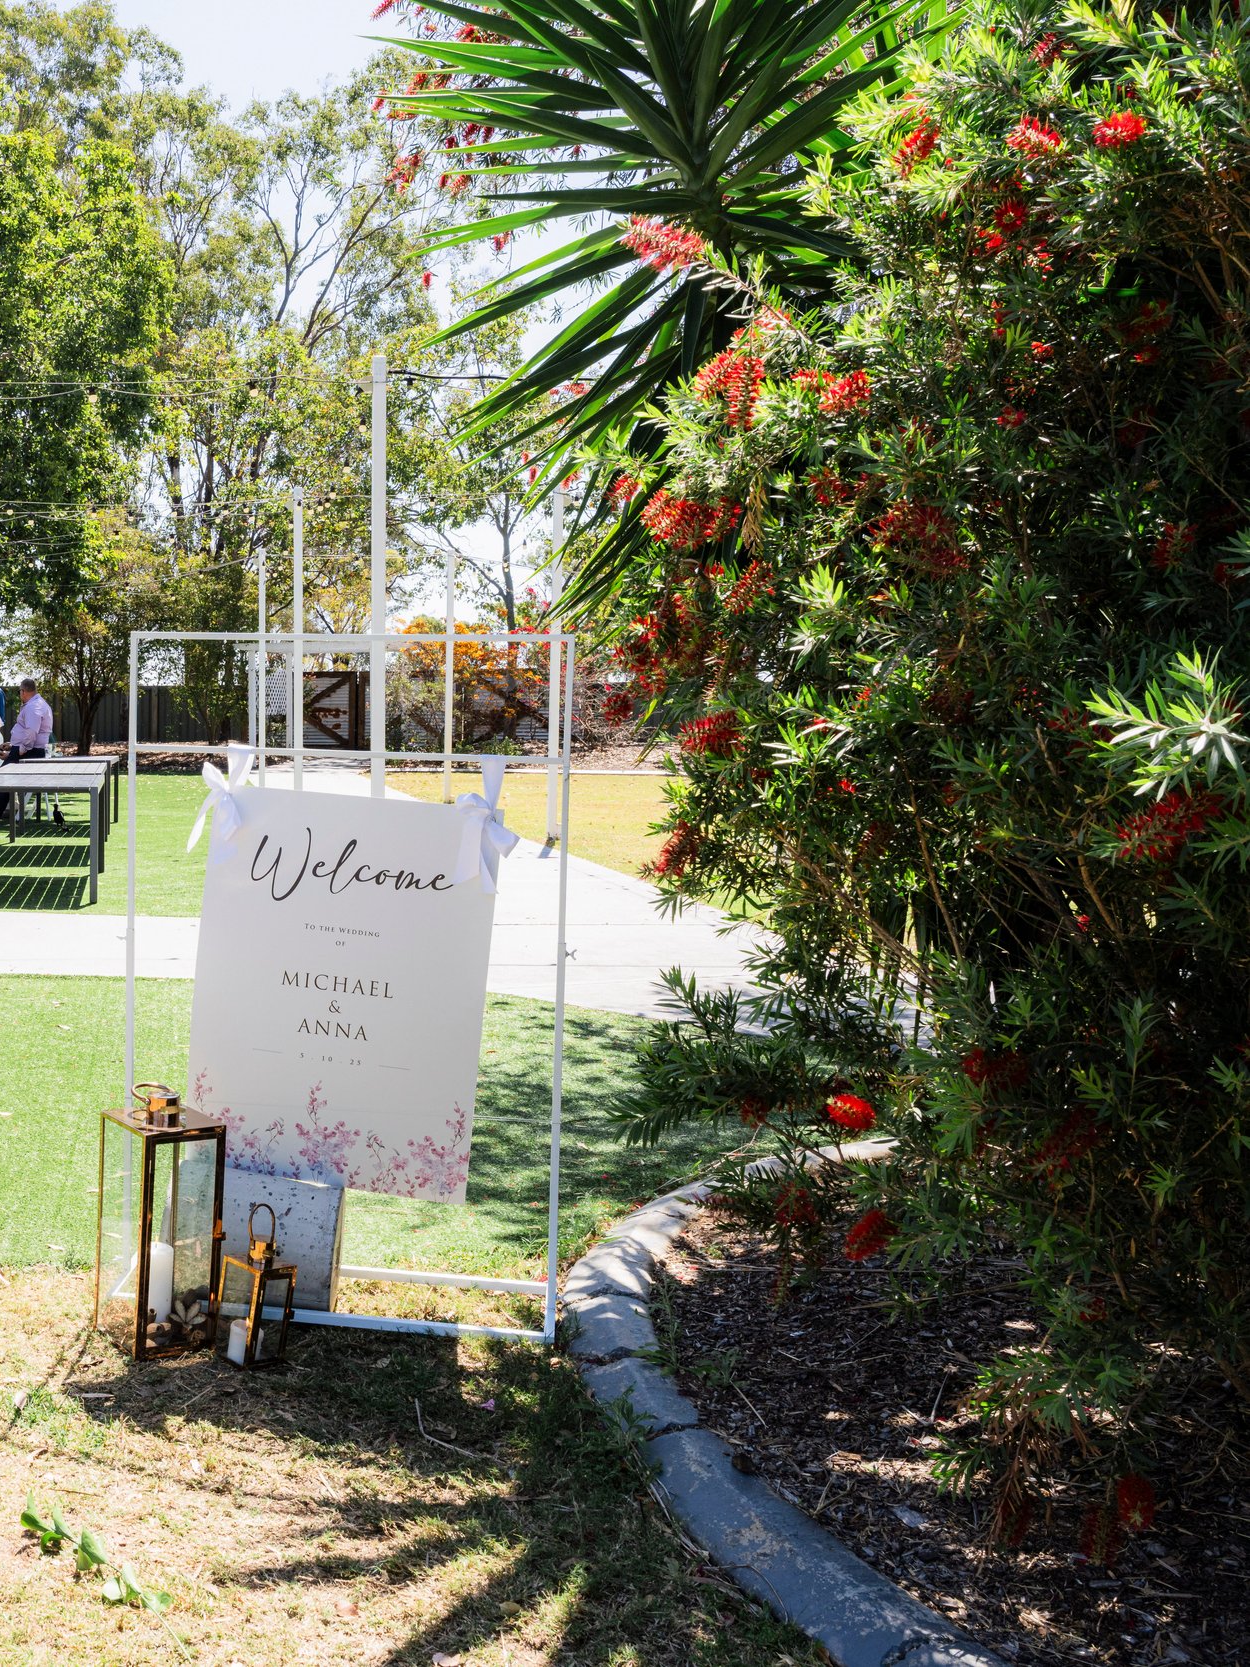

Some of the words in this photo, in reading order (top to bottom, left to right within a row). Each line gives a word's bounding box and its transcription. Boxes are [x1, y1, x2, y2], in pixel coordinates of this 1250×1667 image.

[250, 827, 455, 902] Welcome
[281, 969, 394, 999] MICHAEL
[328, 999, 341, 1014] &
[296, 1017, 369, 1041] ANNA
